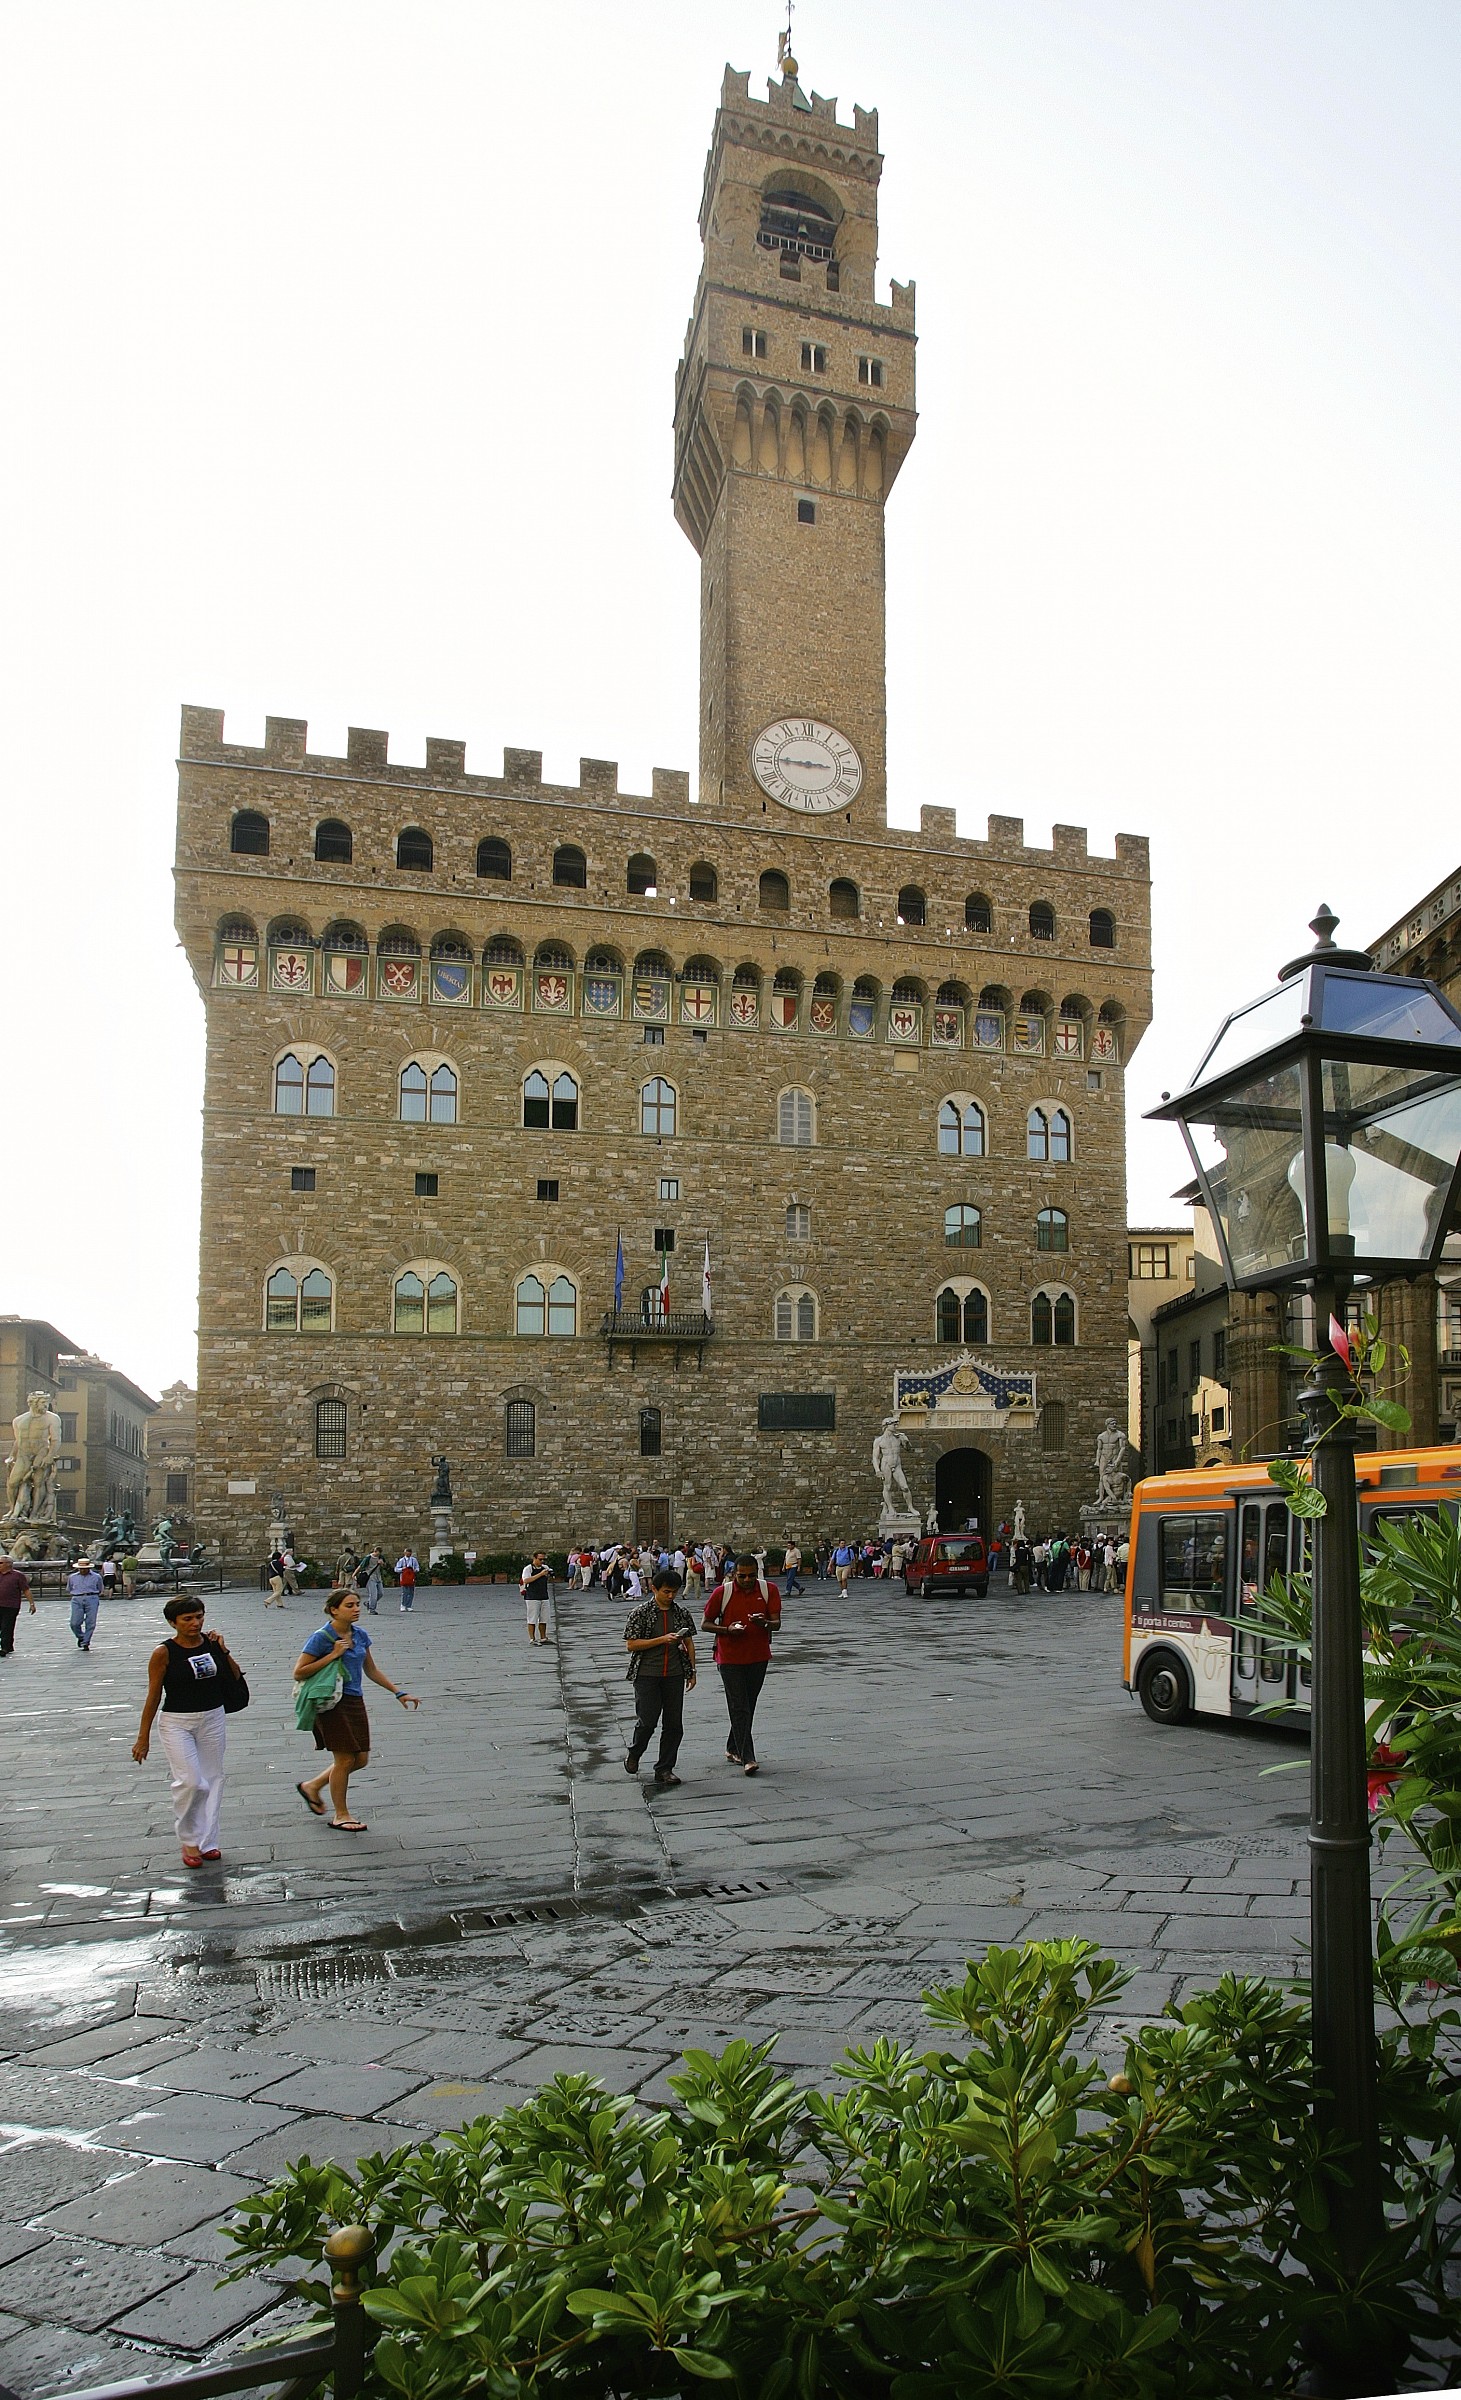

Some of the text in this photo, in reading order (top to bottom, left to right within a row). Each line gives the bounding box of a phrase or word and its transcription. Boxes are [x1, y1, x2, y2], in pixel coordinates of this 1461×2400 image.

[779, 723, 793, 738] XI
[801, 722, 814, 737] XII
[762, 735, 778, 748] X
[824, 732, 834, 743] I
[756, 753, 773, 764] IX
[837, 748, 852, 757] II
[842, 767, 858, 777] III
[761, 771, 779, 787] VIII
[779, 787, 793, 803] VII
[836, 781, 854, 797] IIII
[804, 795, 815, 809] VI
[826, 795, 837, 807] V
[437, 969, 464, 989] LIBERTAS
[1143, 1617, 1162, 1628] porta
